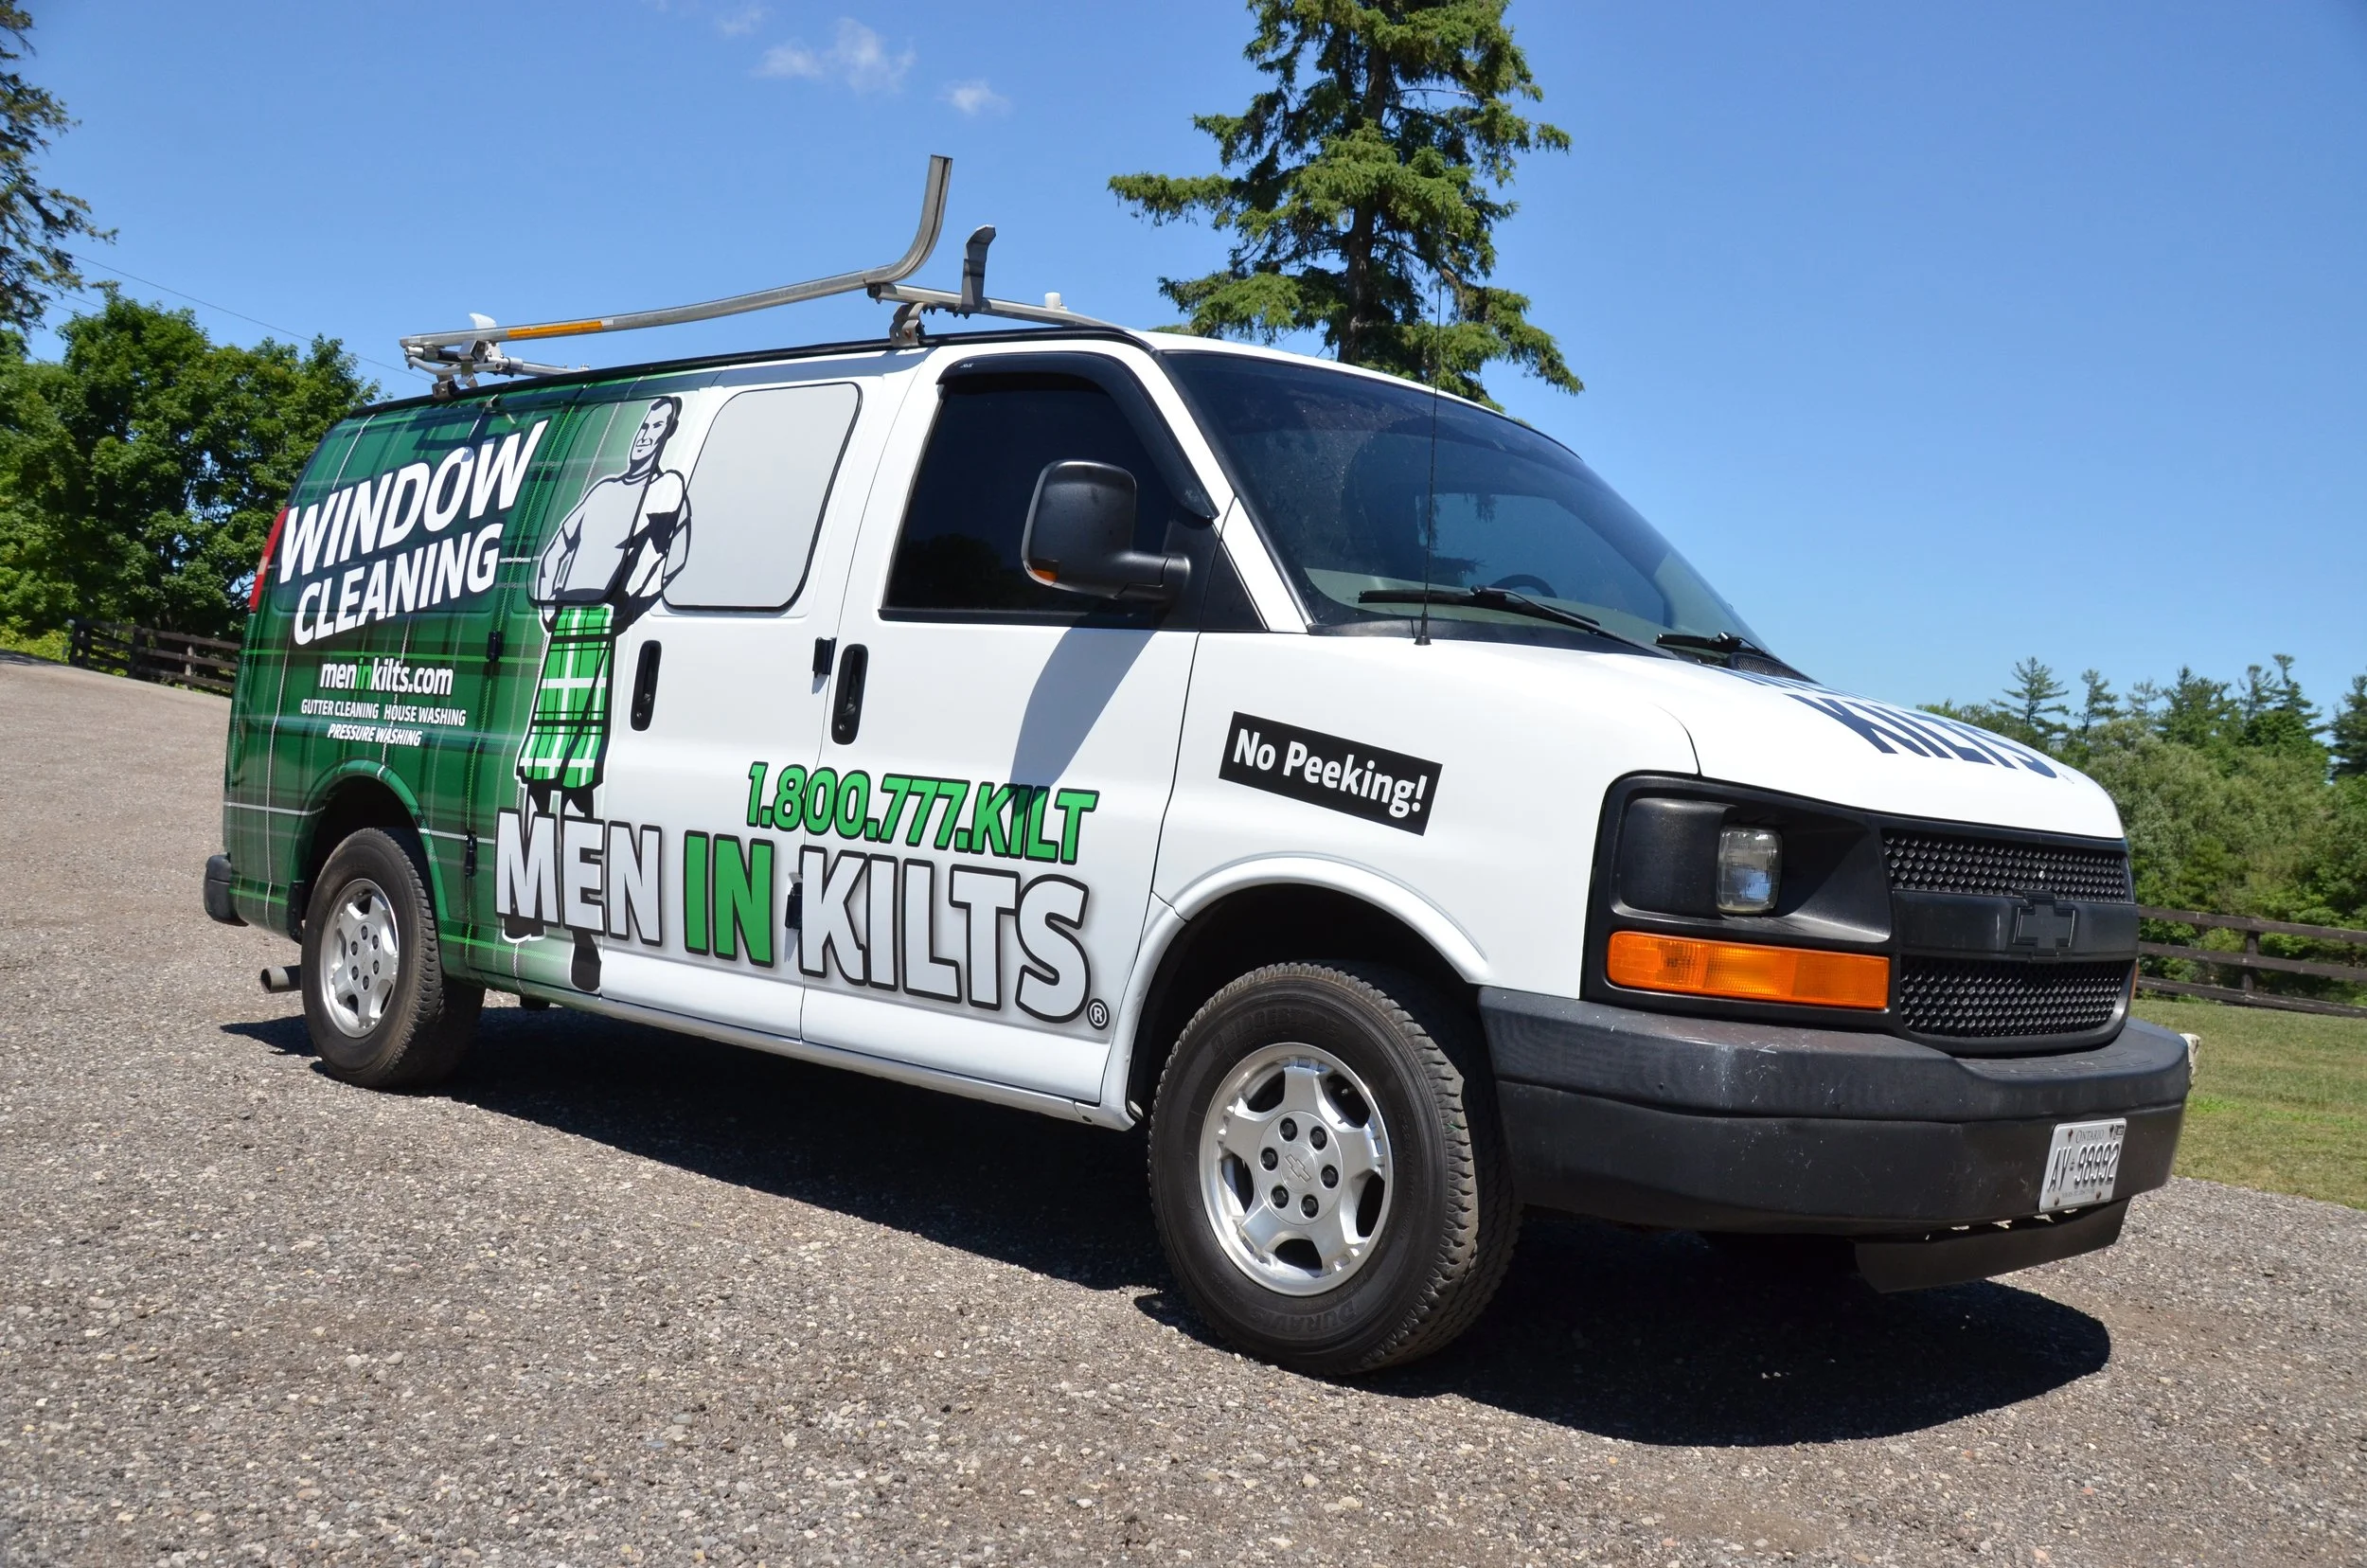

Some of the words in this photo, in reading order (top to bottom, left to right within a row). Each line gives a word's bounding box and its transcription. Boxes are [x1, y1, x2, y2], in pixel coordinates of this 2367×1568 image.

[278, 419, 548, 583] WINDOW
[294, 524, 504, 646] CLEANING
[301, 699, 334, 715] GUTTER
[334, 701, 379, 720] CLEANING
[383, 704, 418, 722] HOUSE
[418, 706, 467, 727] WASHING
[320, 657, 454, 696] meninkilts.com
[328, 723, 376, 742] PRESSURE
[376, 726, 423, 747] WASHING
[1233, 728, 1276, 771] No
[1283, 740, 1428, 819] Peeking!
[746, 761, 1099, 864] 1.800.777.KILT
[495, 809, 663, 946] MEN
[683, 829, 776, 968] IN
[799, 845, 1090, 1024] KILTS
[2075, 1129, 2105, 1144] ONTARIO
